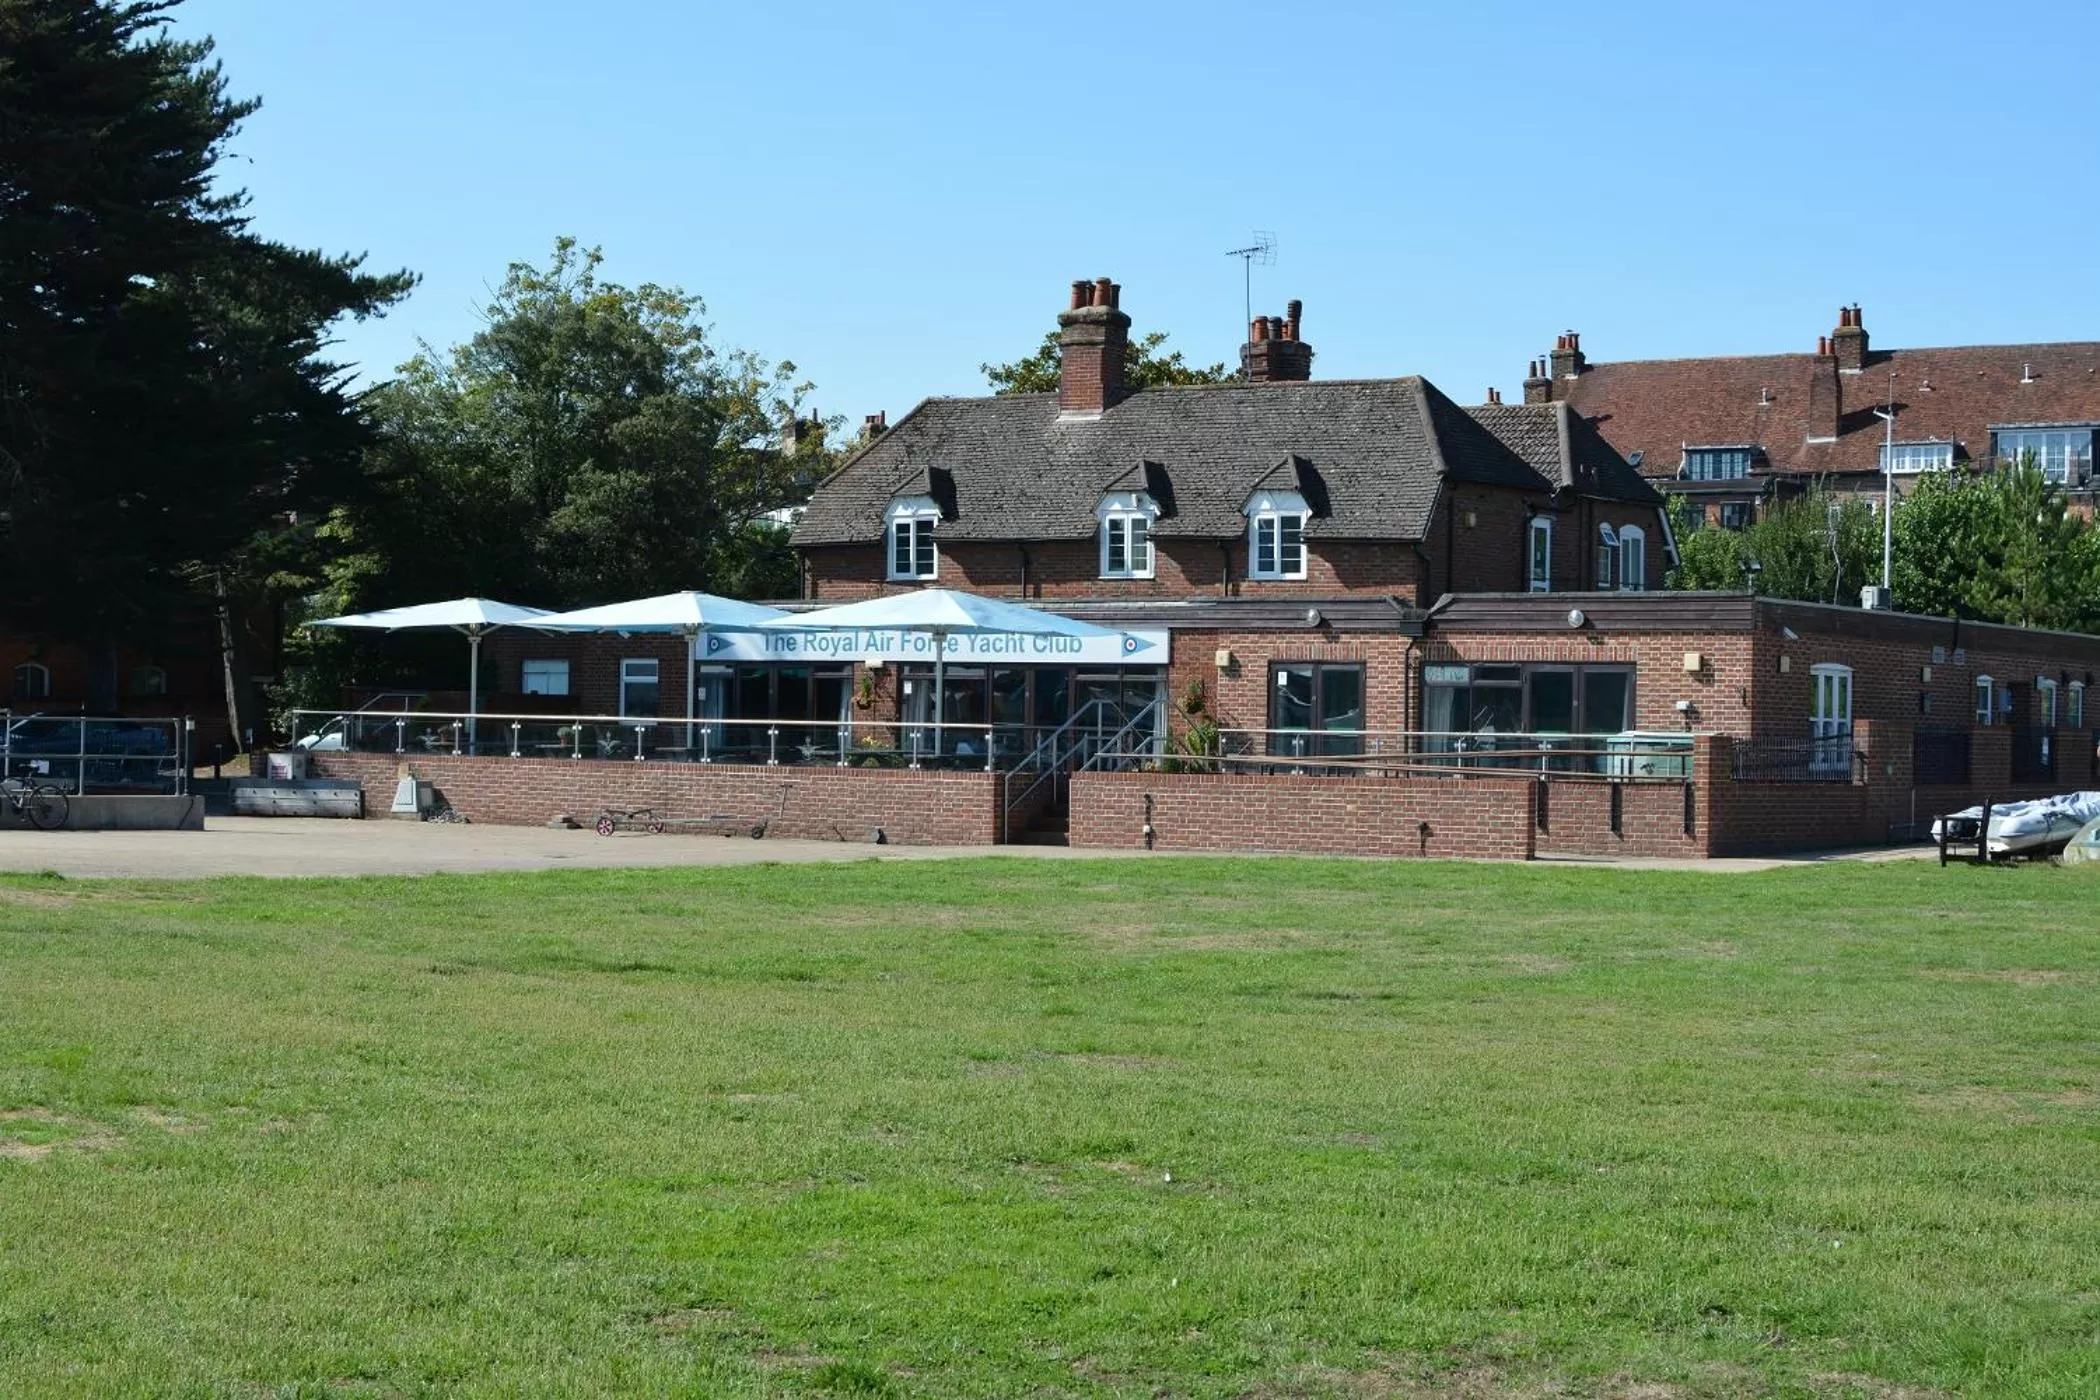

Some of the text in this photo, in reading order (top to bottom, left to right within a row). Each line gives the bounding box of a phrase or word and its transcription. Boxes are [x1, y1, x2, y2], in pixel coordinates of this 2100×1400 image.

[763, 632, 1082, 657] The Royal Air Fore Yacht Club
